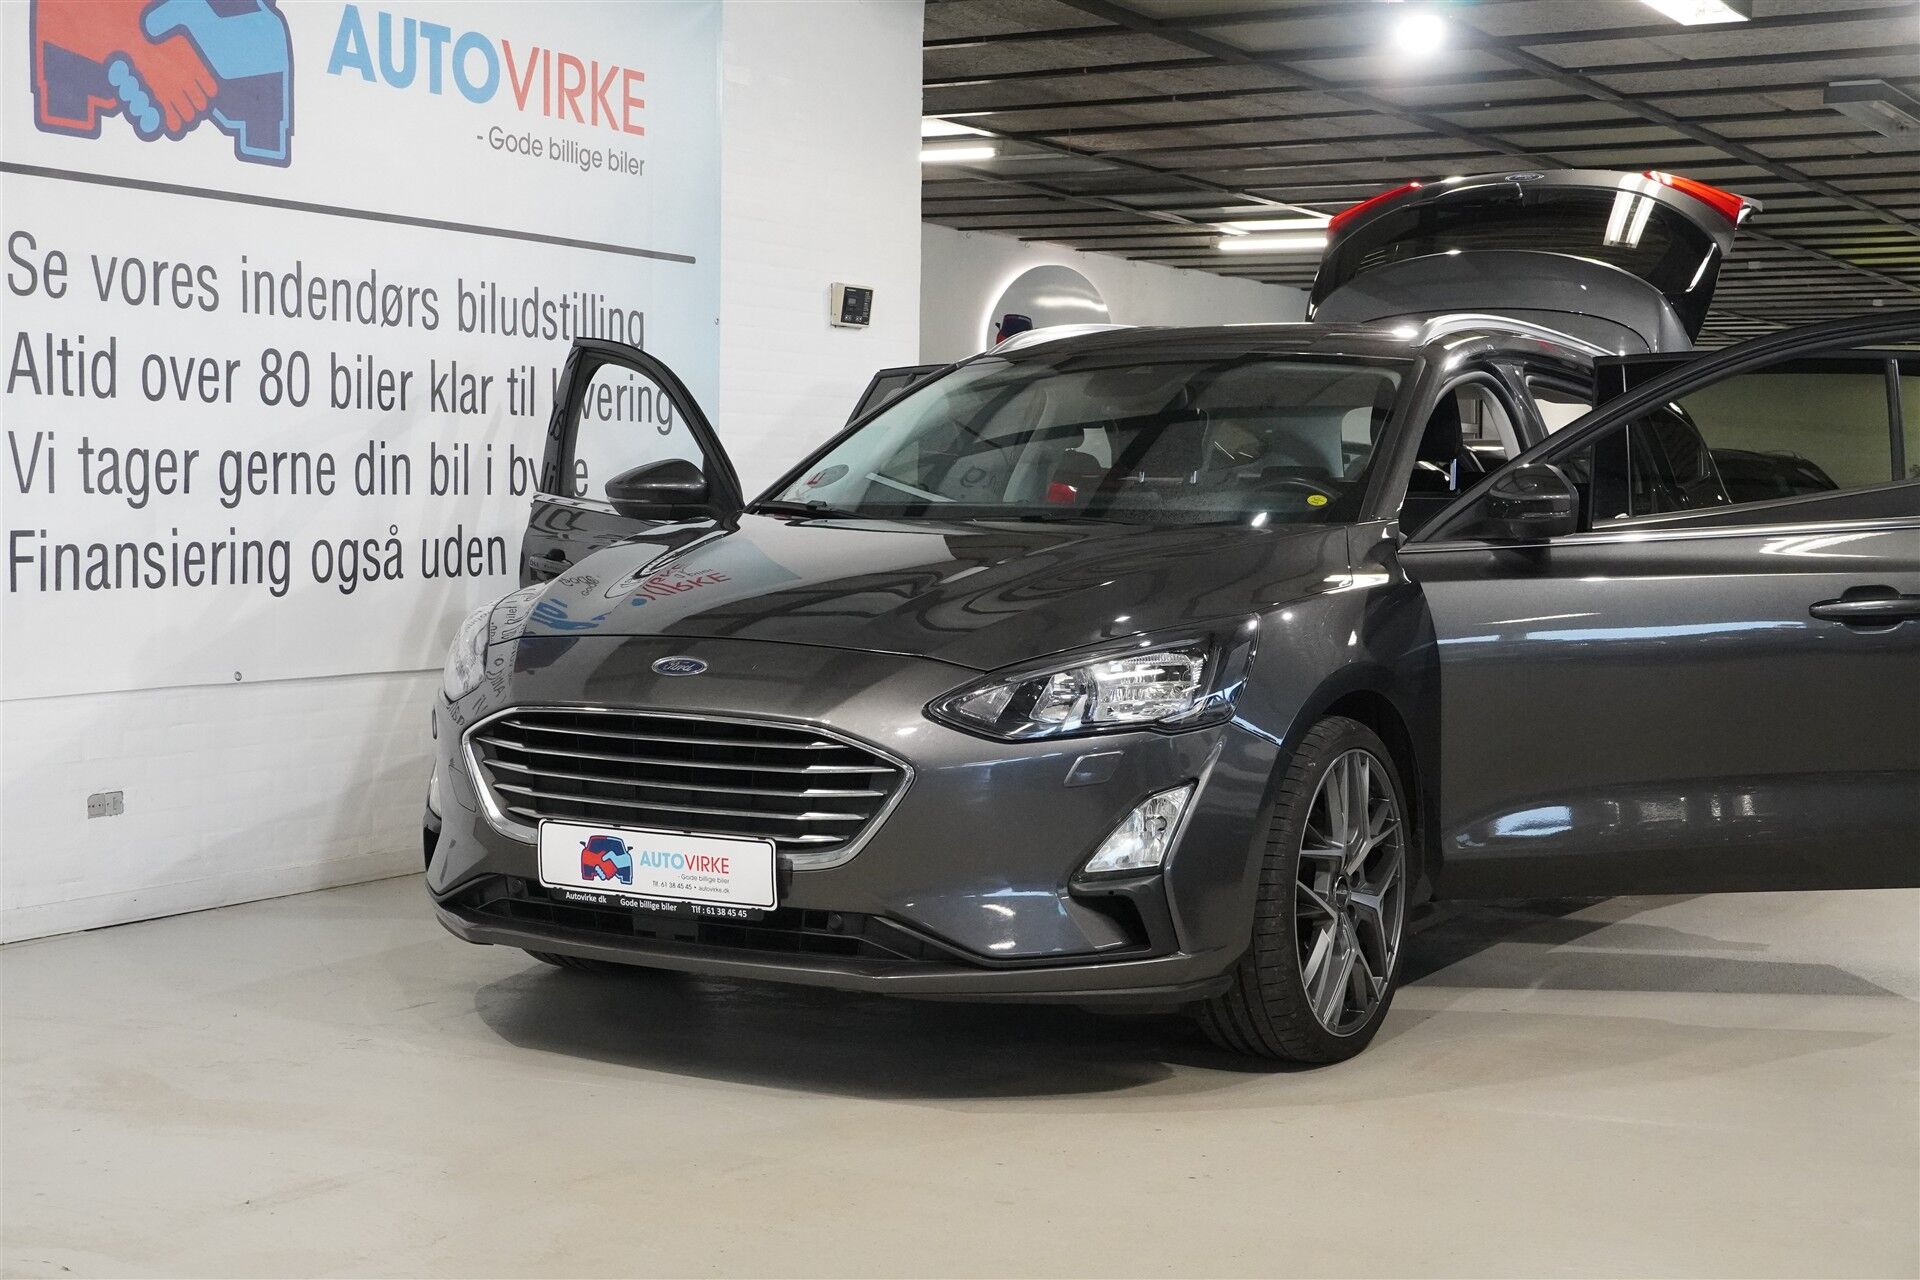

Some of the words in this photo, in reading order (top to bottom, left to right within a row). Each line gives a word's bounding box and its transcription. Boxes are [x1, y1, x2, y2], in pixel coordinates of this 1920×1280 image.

[328, 4, 645, 136] AUTOVIRKE
[488, 126, 543, 157] Gode
[549, 137, 603, 172] billige
[608, 148, 645, 176] biler
[7, 230, 68, 300] Se
[90, 254, 220, 312] vores
[241, 254, 440, 331] indendørs
[457, 277, 645, 350] biludstilling
[6, 331, 117, 400] Altid
[141, 353, 241, 404] over
[259, 347, 311, 408] 80
[330, 351, 414, 412] biler
[430, 358, 494, 415] klar
[506, 364, 536, 417] til
[552, 367, 674, 437] lvering
[7, 431, 56, 494] Vi
[77, 436, 200, 510] tager
[218, 449, 336, 511] gerne
[354, 439, 411, 497] din
[430, 441, 469, 497] bil
[486, 443, 493, 496] i
[9, 526, 291, 598] Finansiering
[311, 523, 404, 596] også
[421, 523, 507, 580] uden
[640, 850, 729, 874] AUTOVIRKE
[620, 898, 638, 908] Gode
[639, 899, 660, 911] billige
[661, 902, 678, 912] biler
[706, 907, 716, 915] 61
[717, 908, 726, 916] 38
[727, 909, 737, 917] 45
[737, 910, 747, 918] 45
